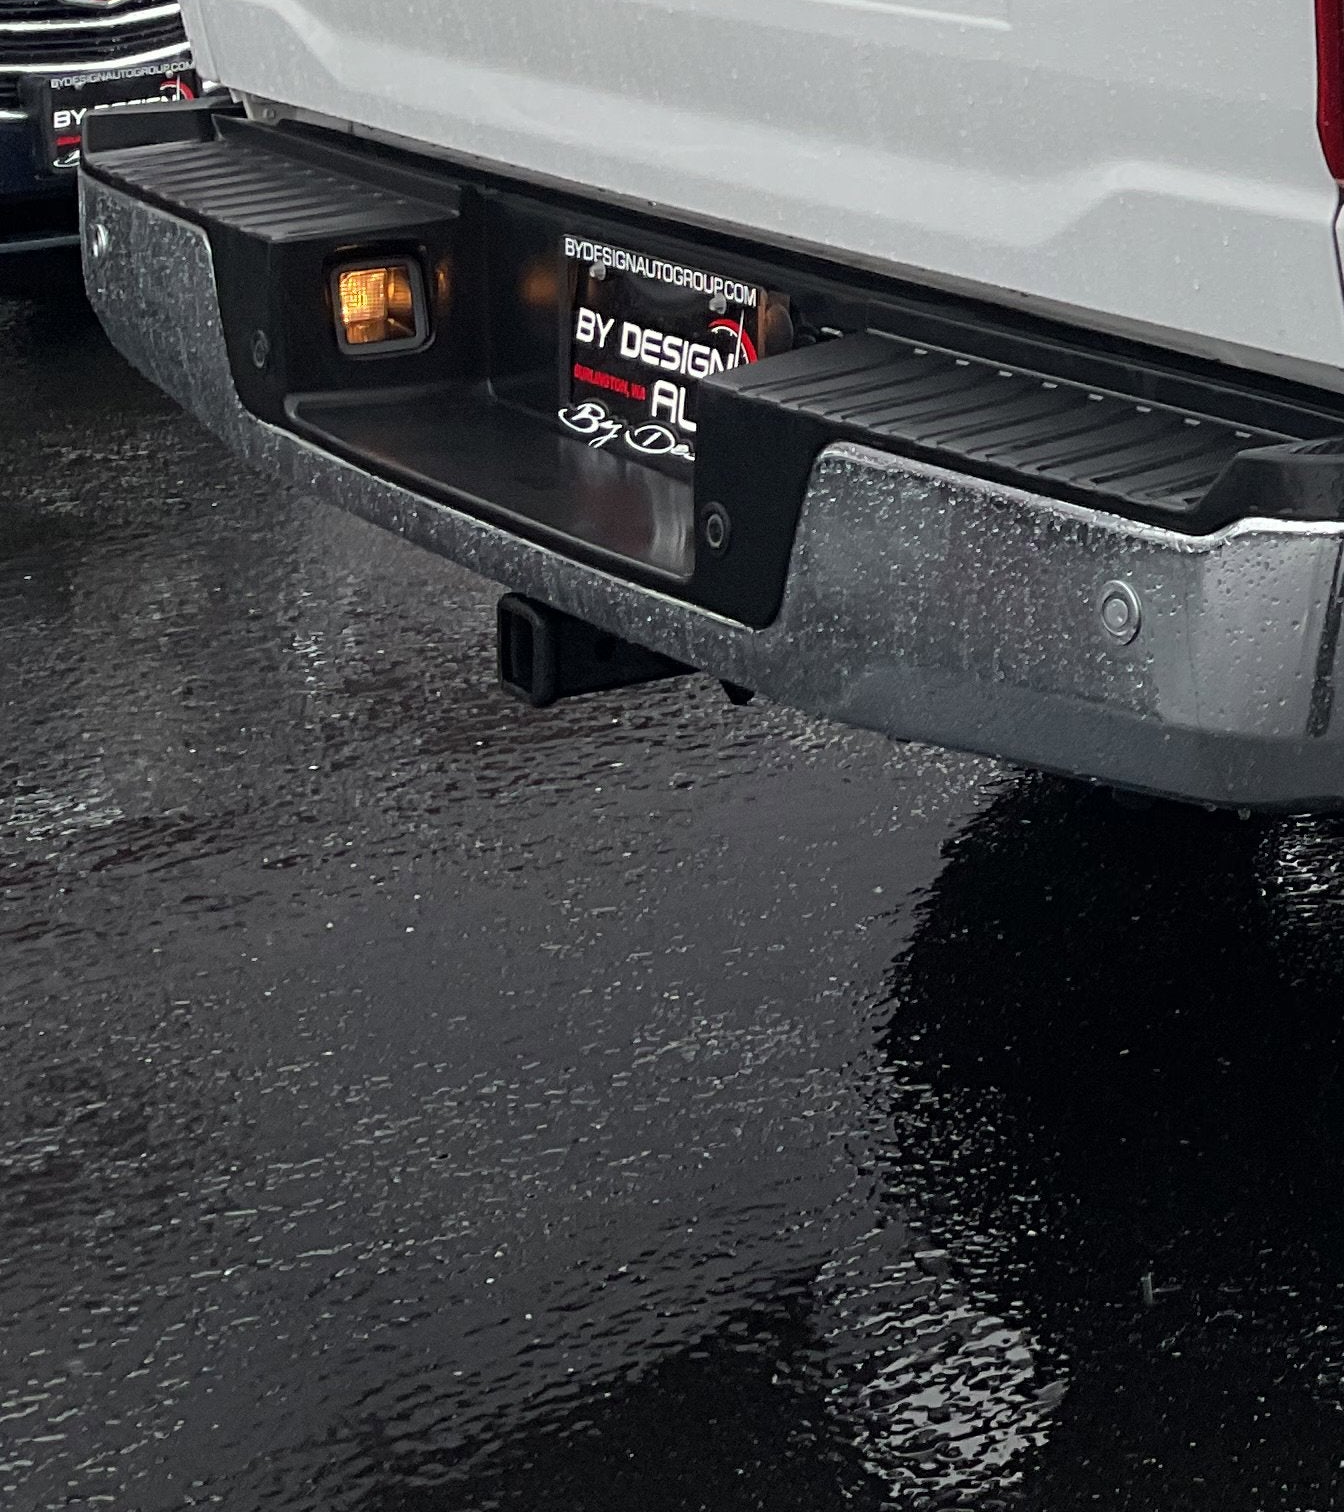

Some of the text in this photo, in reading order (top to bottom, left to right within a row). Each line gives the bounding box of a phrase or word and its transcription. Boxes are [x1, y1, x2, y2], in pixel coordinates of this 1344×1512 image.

[53, 108, 87, 129] BY
[575, 306, 736, 379] BY DESIGN
[558, 402, 623, 448] By
